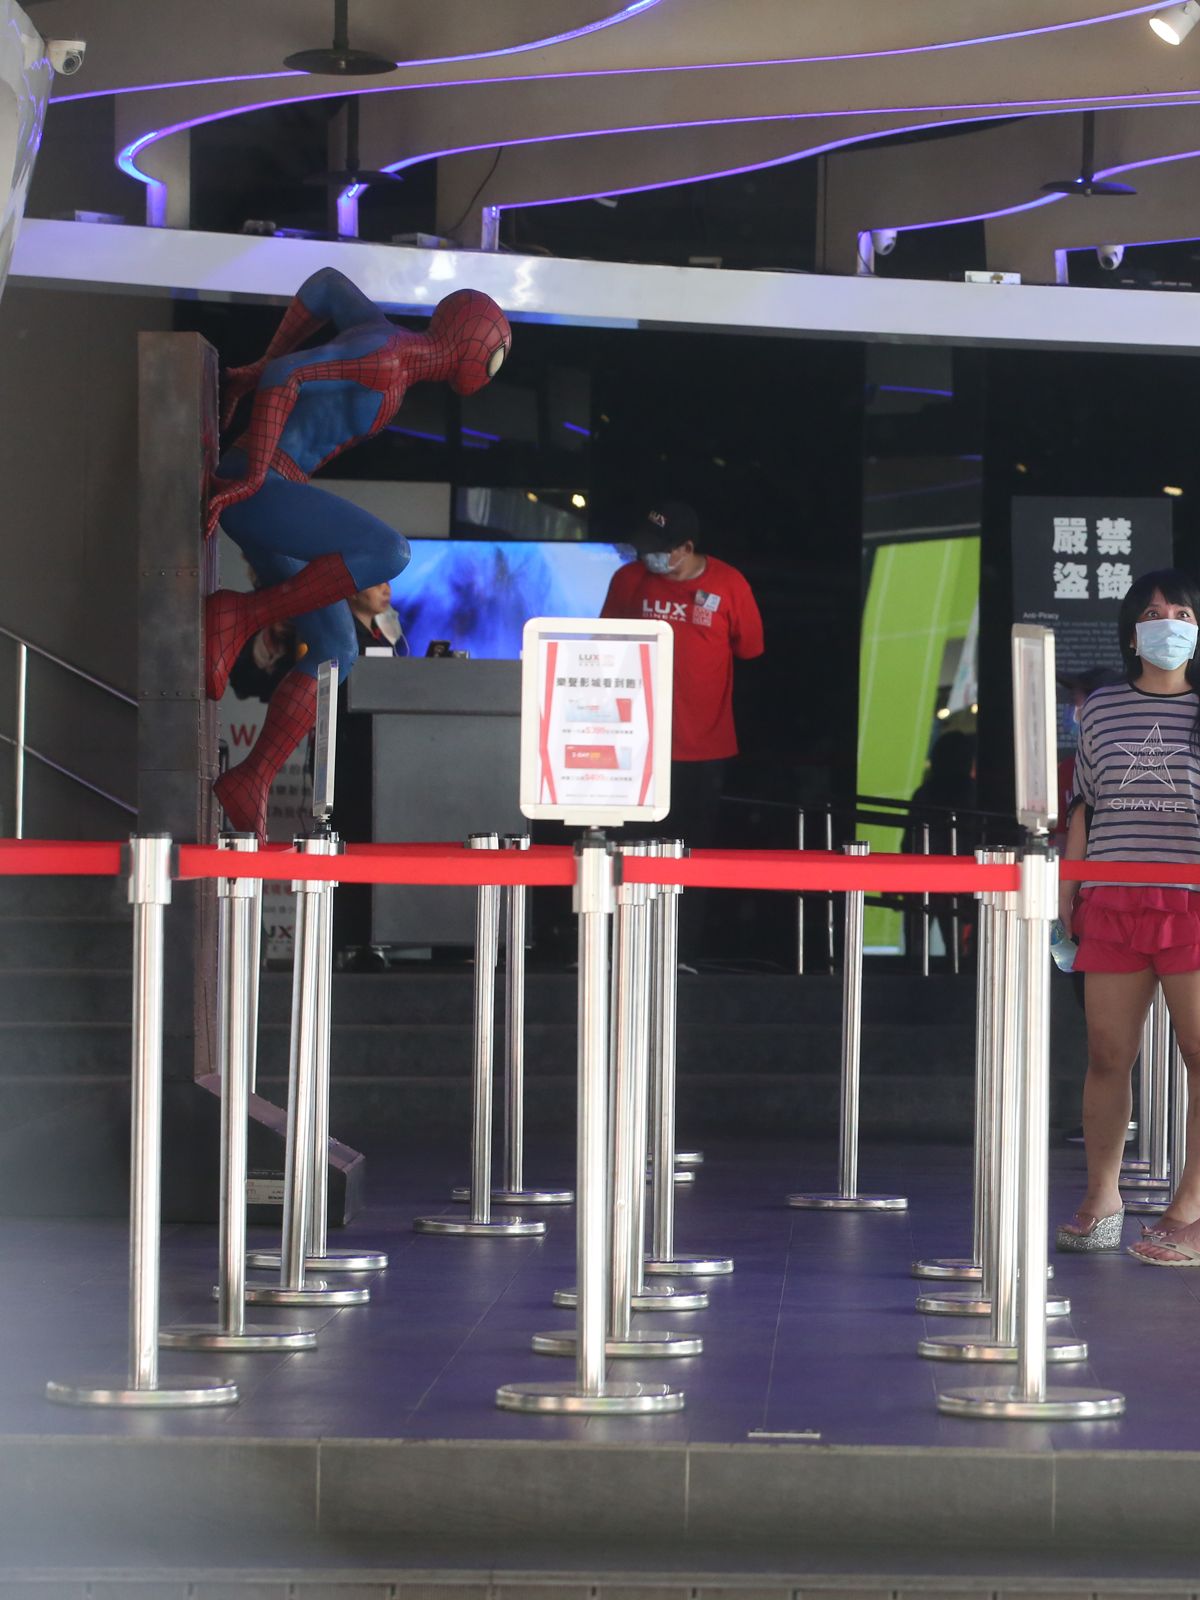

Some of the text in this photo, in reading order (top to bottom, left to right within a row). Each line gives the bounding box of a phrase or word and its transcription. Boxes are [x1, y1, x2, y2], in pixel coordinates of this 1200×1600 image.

[1053, 517, 1132, 555] 嚴禁
[1053, 562, 1133, 600] 盜錄
[642, 599, 688, 617] LUX
